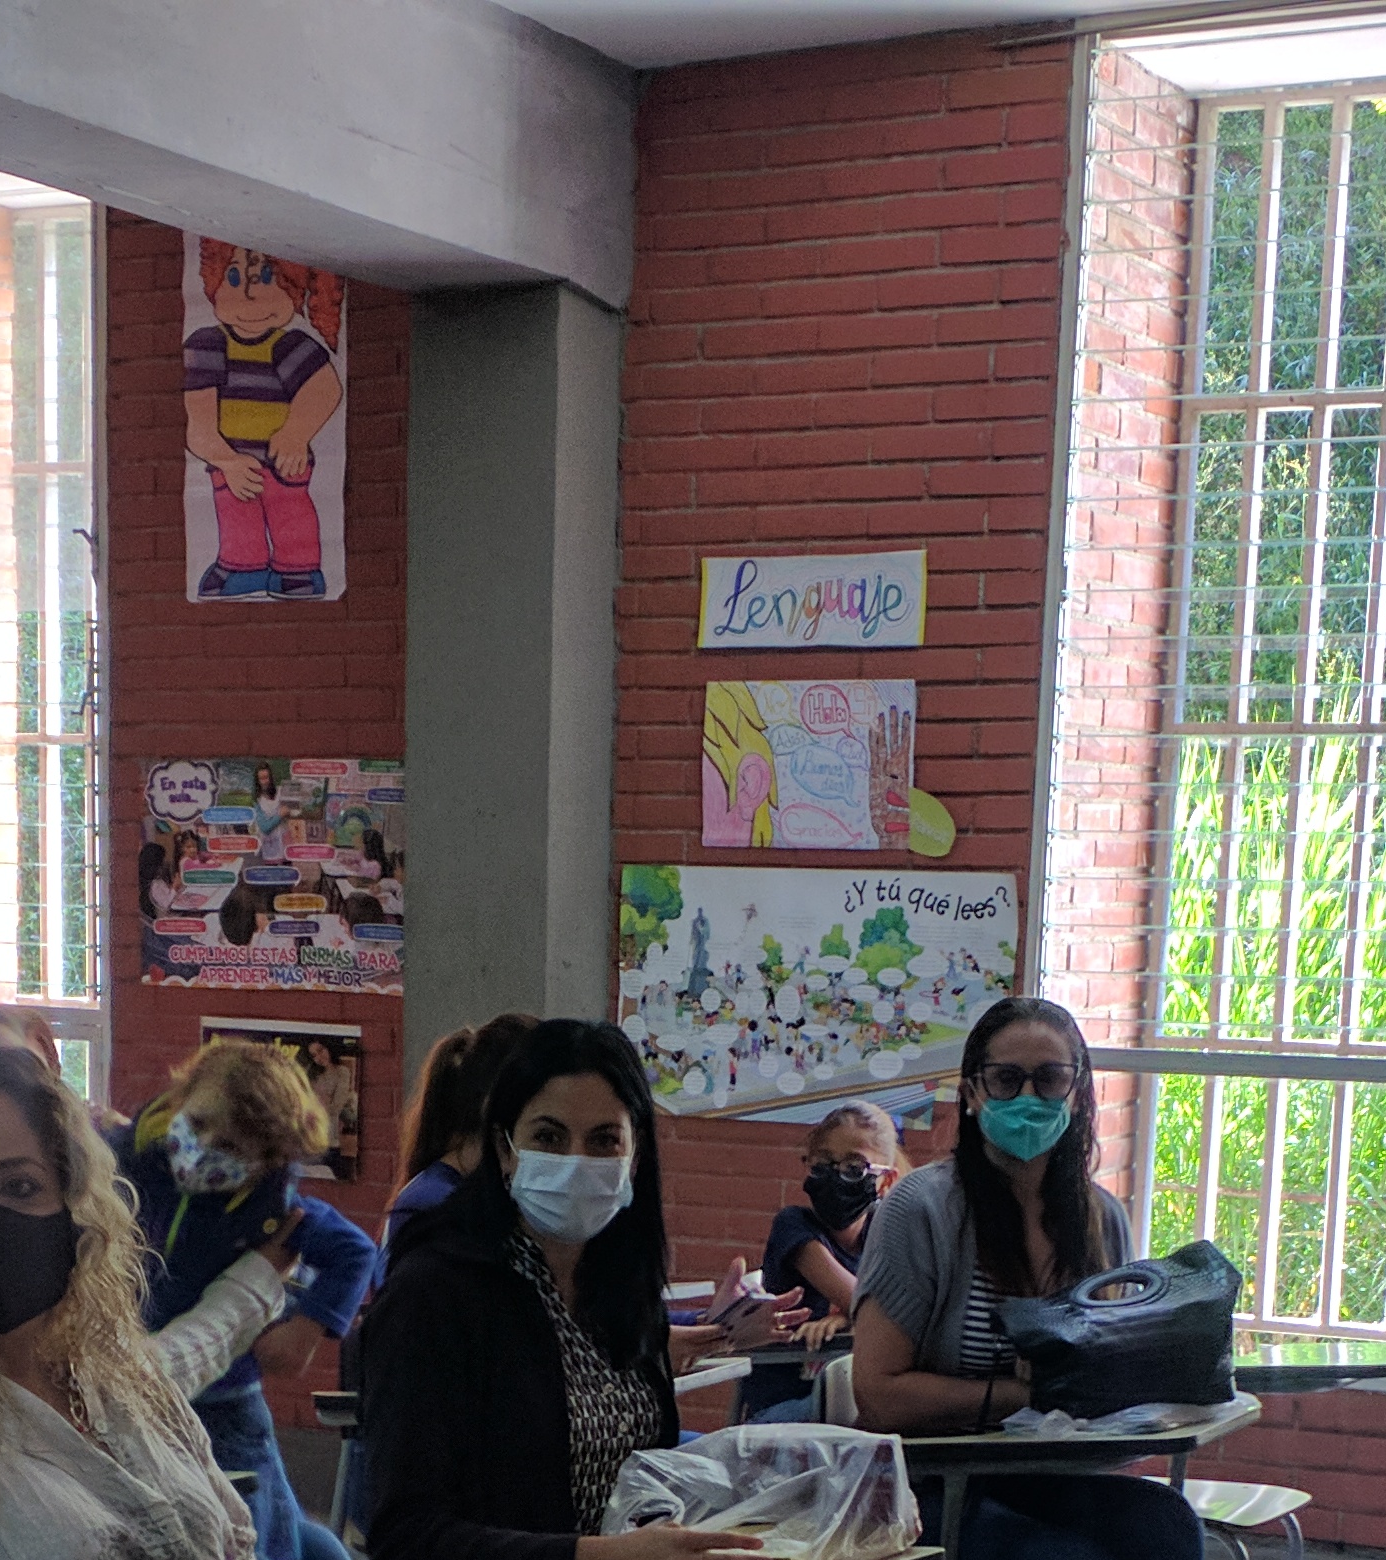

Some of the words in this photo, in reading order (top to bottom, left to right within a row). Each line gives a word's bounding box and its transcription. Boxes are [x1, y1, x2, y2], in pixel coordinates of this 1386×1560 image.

[715, 559, 908, 640] Lenguaje
[808, 692, 847, 725] Hola
[160, 776, 176, 791] En
[844, 879, 867, 913] ¿Y
[876, 878, 901, 902] tú
[908, 888, 951, 916] qué
[953, 886, 1011, 921] lees?
[169, 945, 247, 964] CUMPLIMOS
[251, 946, 297, 964] ESTAS
[300, 946, 353, 967] NORMAS
[357, 951, 400, 970] PARA
[200, 966, 270, 985] APRENDER
[305, 967, 315, 983] Y
[317, 968, 363, 987] MEJOR
